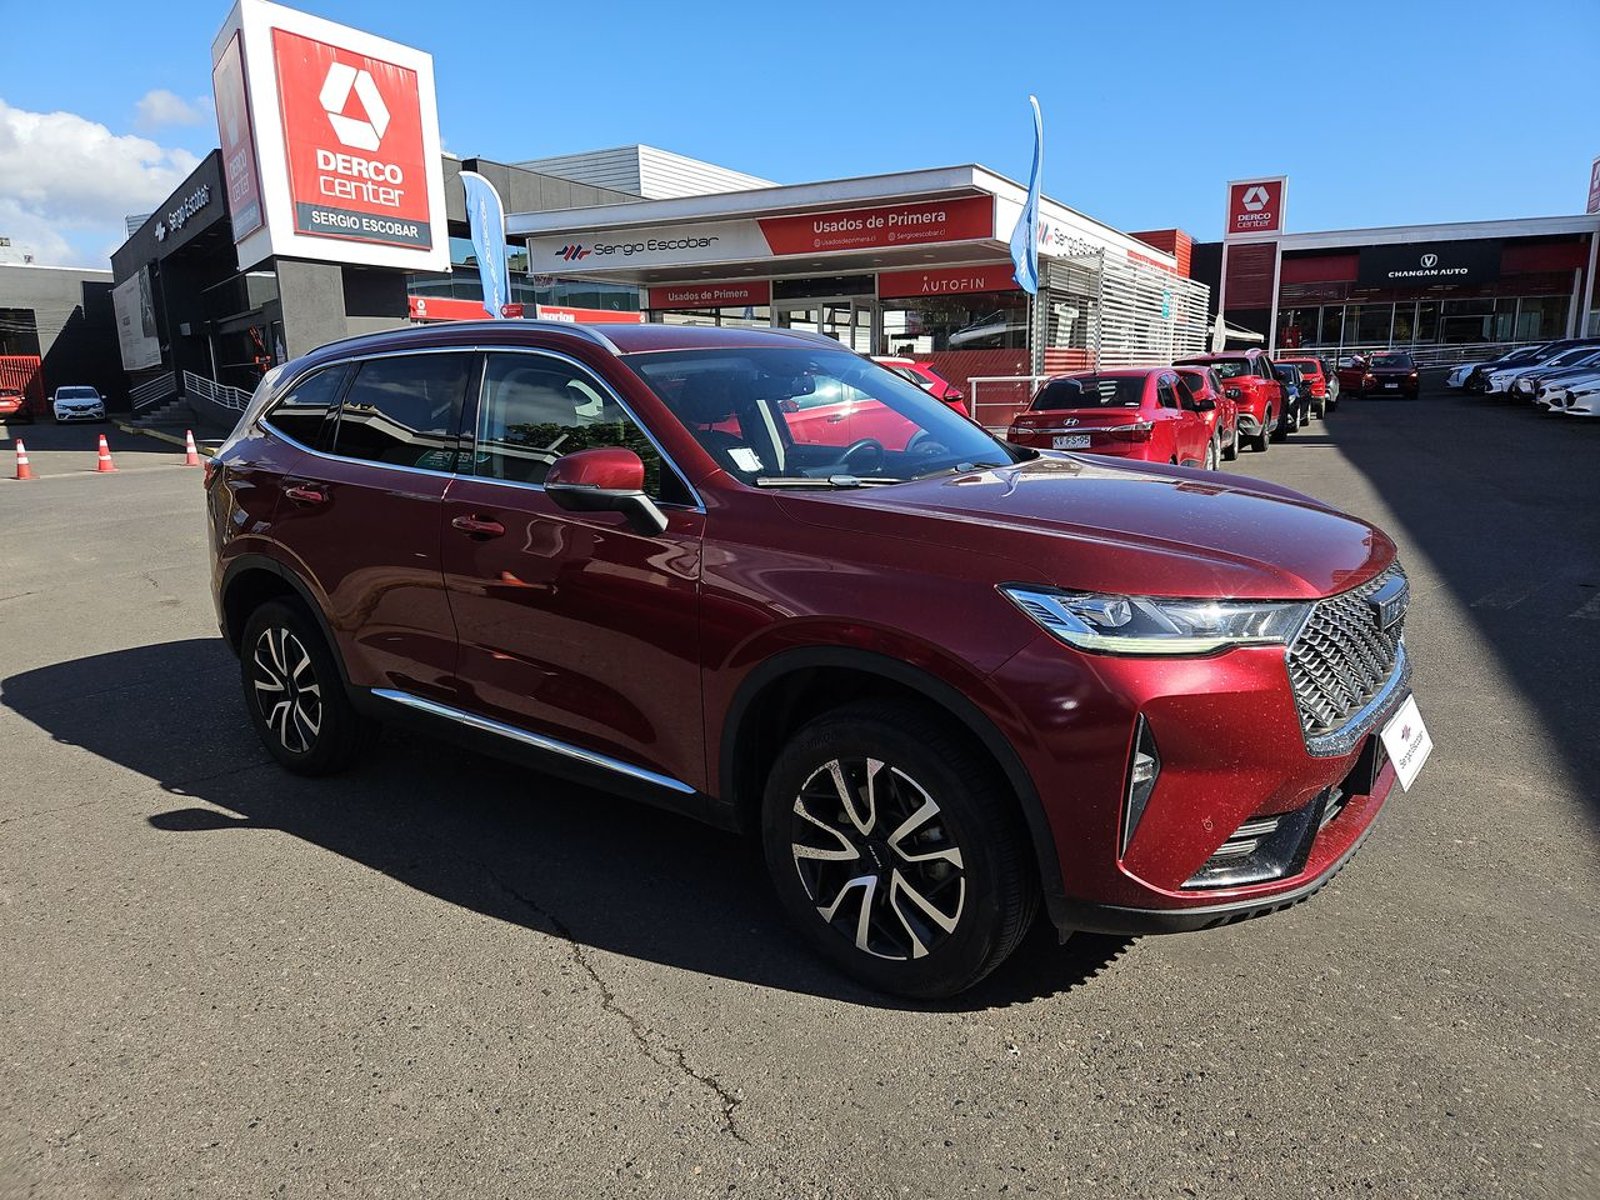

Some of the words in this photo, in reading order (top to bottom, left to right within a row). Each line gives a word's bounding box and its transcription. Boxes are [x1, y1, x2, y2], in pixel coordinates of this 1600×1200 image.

[316, 149, 404, 185] DERCO
[319, 175, 405, 208] center
[311, 210, 360, 230] SERGIO
[361, 218, 420, 239] ESCOBAR
[813, 218, 863, 234] Usados
[866, 215, 884, 229] de
[888, 211, 946, 226] Primera
[1238, 212, 1271, 221] DERCO
[594, 243, 645, 256] Sergio
[647, 236, 720, 251] Escobar
[1388, 269, 1438, 278] CHANGAN
[1440, 267, 1468, 275] AUTO
[922, 275, 985, 293] AUTOFIN
[668, 292, 699, 302] Usados
[700, 291, 712, 300] de
[714, 289, 749, 299] Primera
